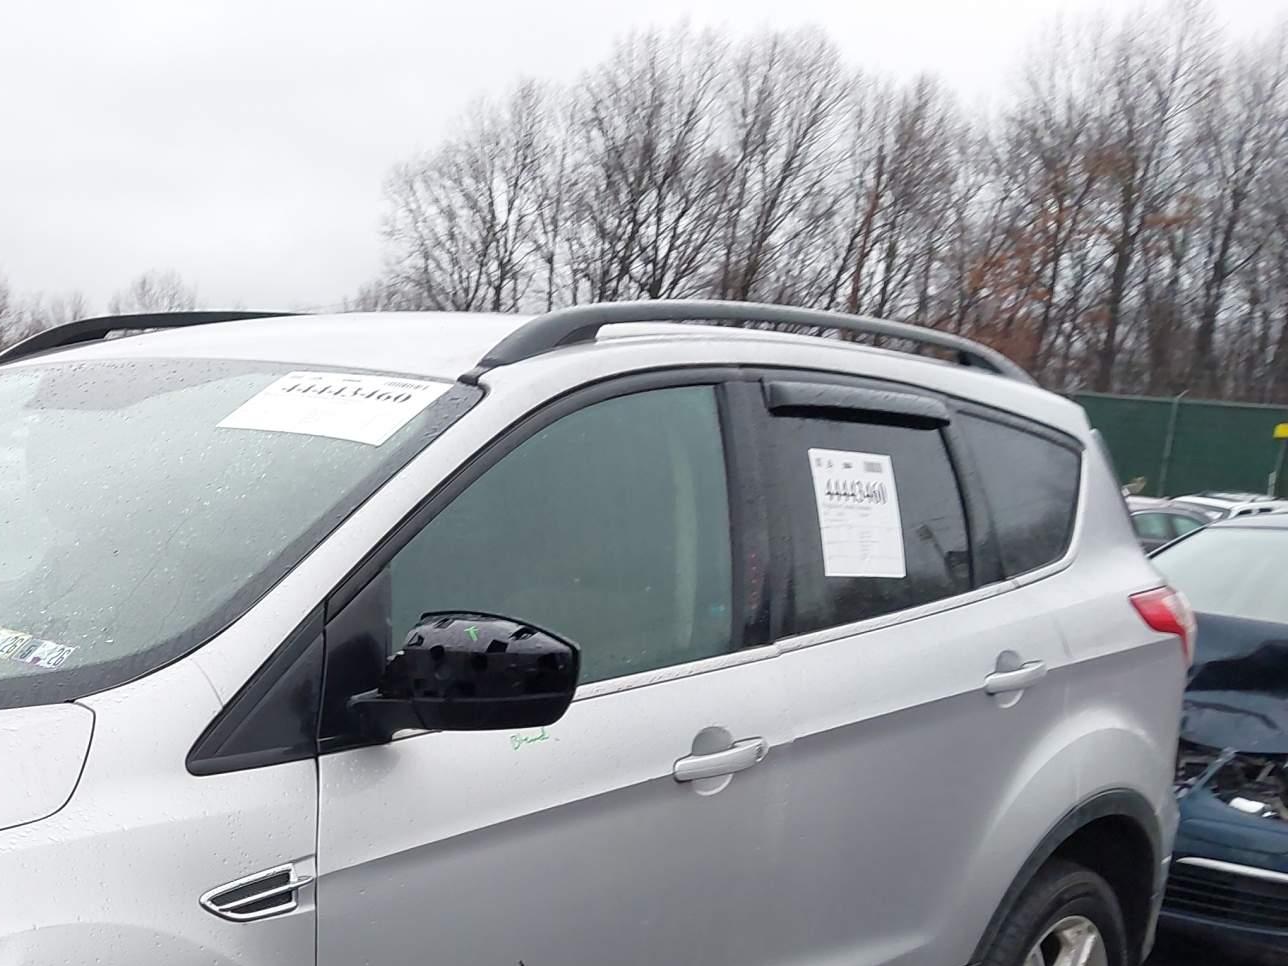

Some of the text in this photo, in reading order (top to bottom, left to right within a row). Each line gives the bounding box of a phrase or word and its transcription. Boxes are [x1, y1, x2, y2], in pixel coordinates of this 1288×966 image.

[282, 385, 412, 403] 44443460
[825, 479, 887, 505] 44443460
[47, 647, 72, 666] 26
